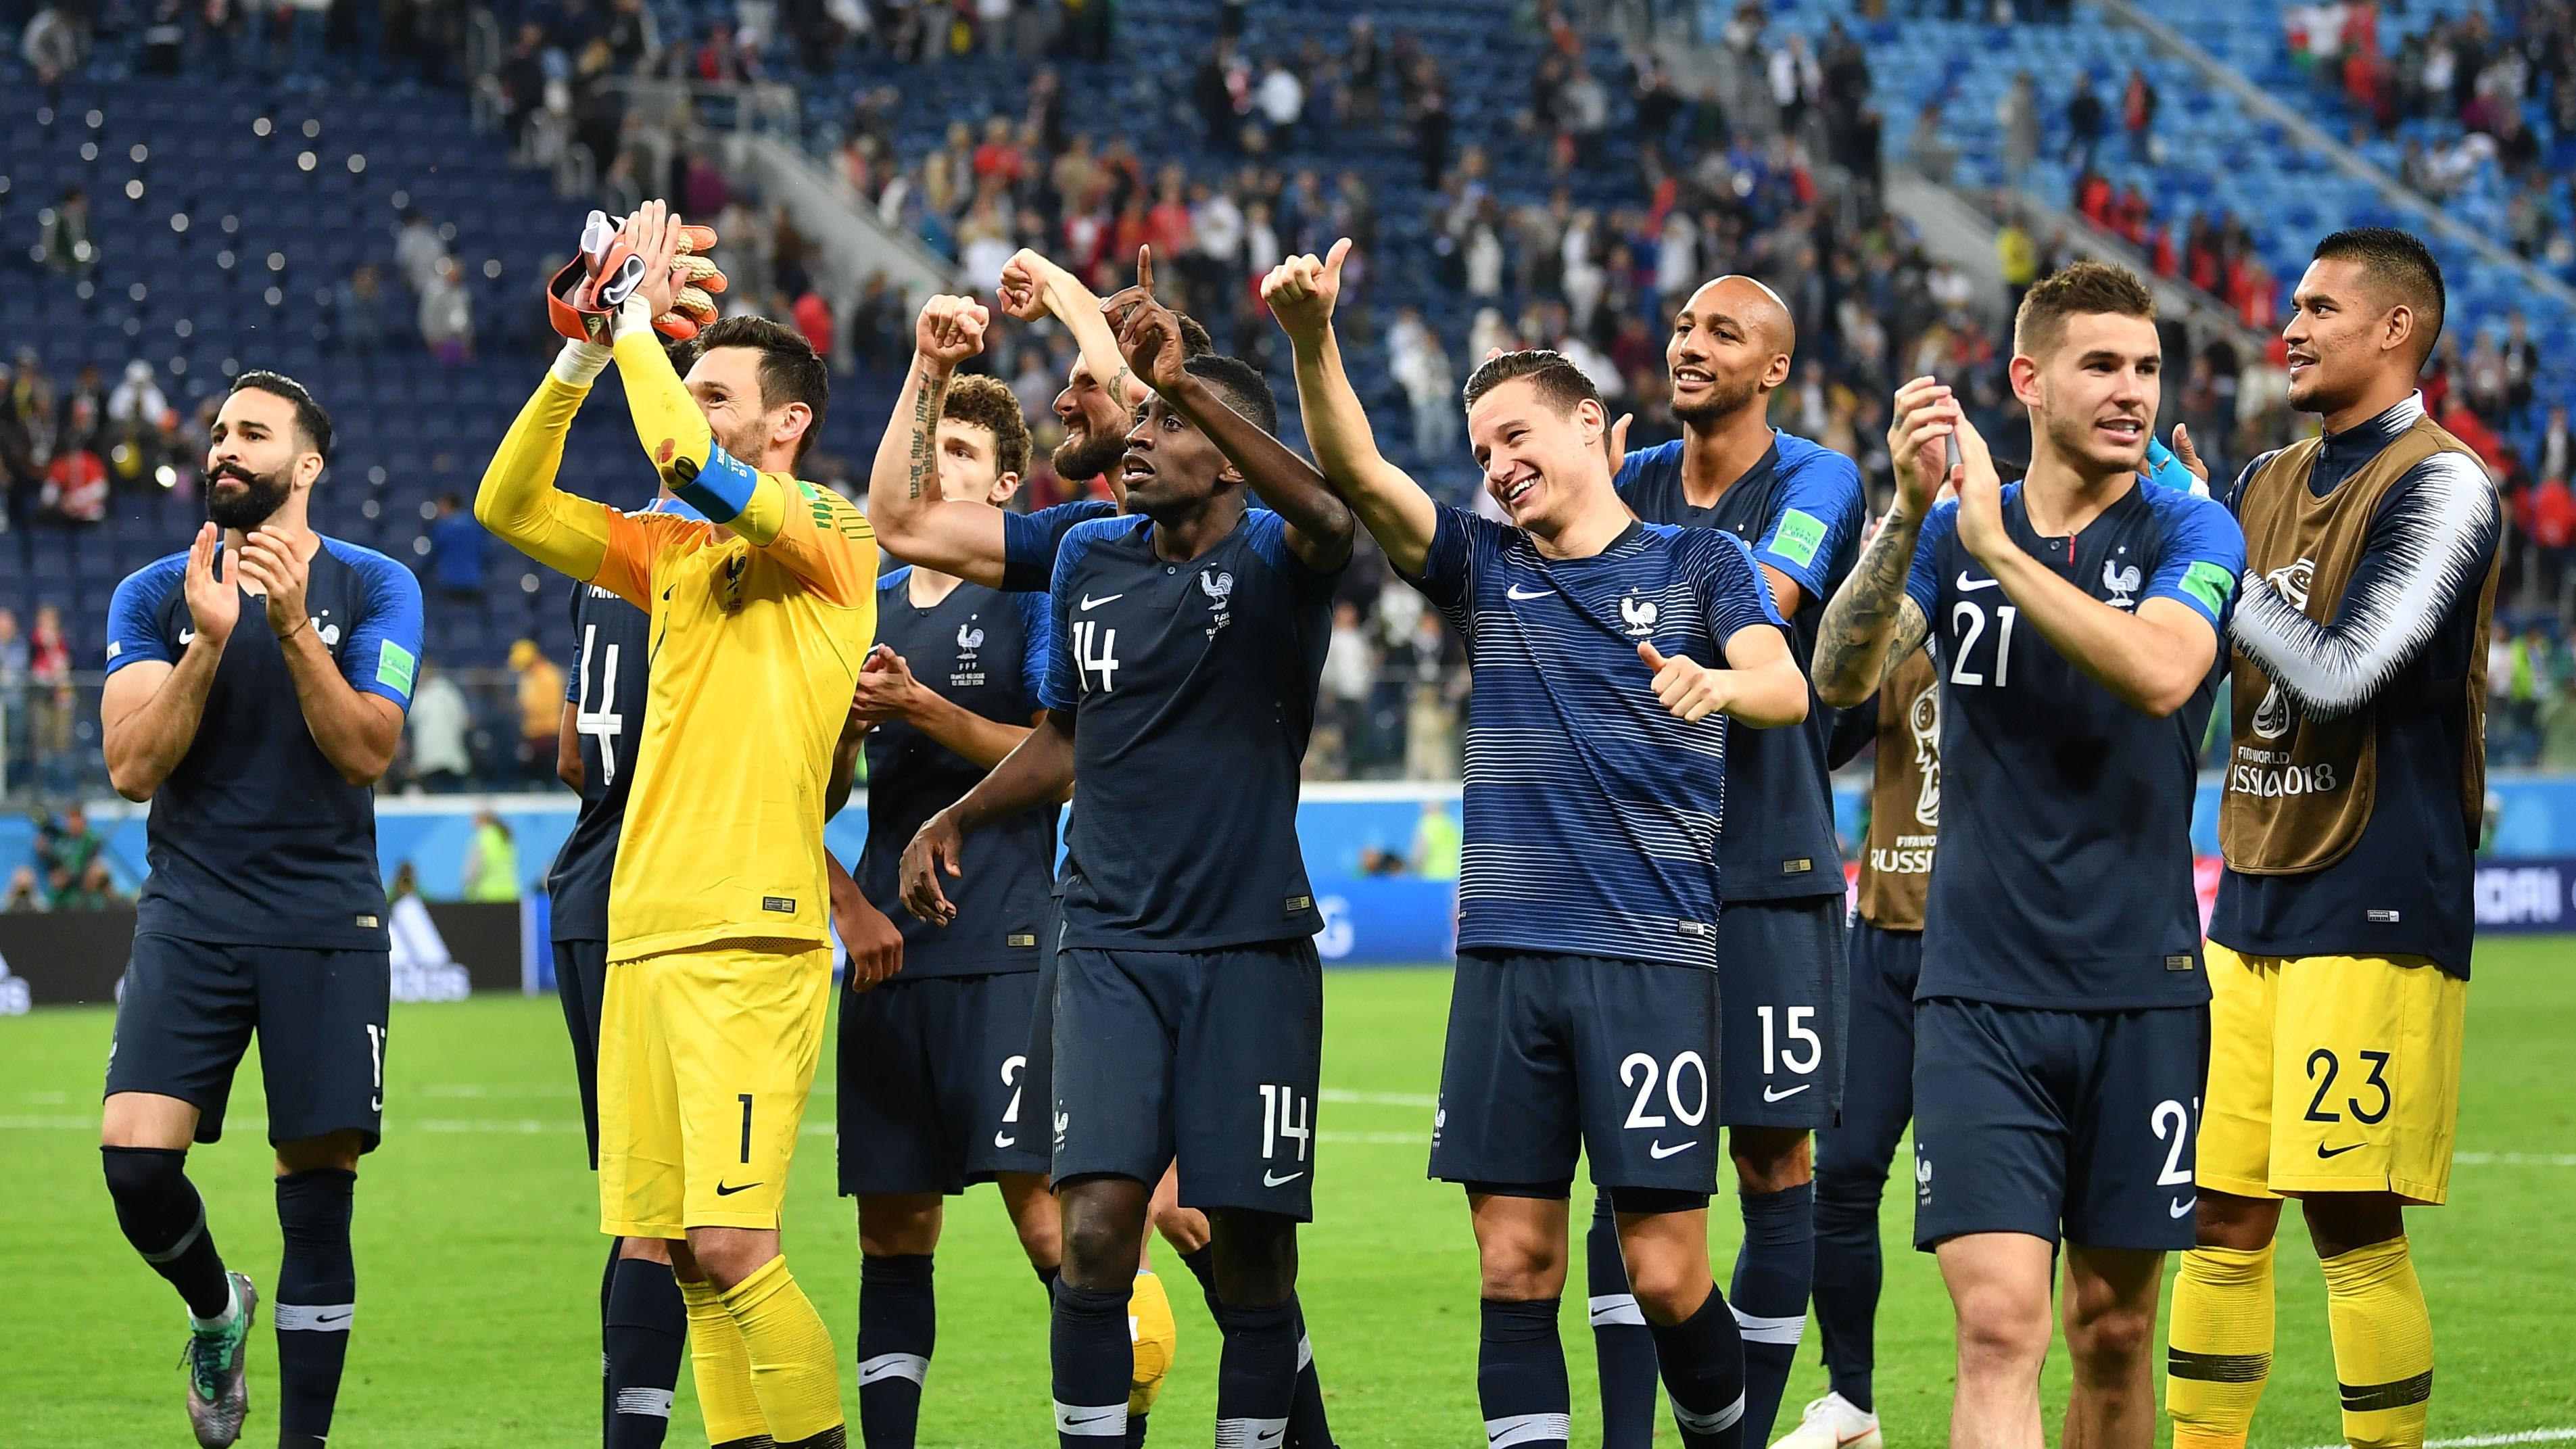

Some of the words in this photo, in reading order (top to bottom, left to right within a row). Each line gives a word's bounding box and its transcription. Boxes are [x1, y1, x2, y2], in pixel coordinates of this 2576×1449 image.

[1073, 621, 1119, 692] 14
[1950, 600, 2016, 687] 21
[576, 624, 622, 786] 4
[2251, 749, 2291, 765] WORLD
[366, 1023, 386, 1089] 1
[1757, 1006, 1822, 1075] 15
[1259, 1084, 1310, 1162] 14
[1620, 1051, 1708, 1129] 20
[2304, 1047, 2391, 1125] 23
[738, 1093, 753, 1164] 1
[2151, 1096, 2199, 1186] 2
